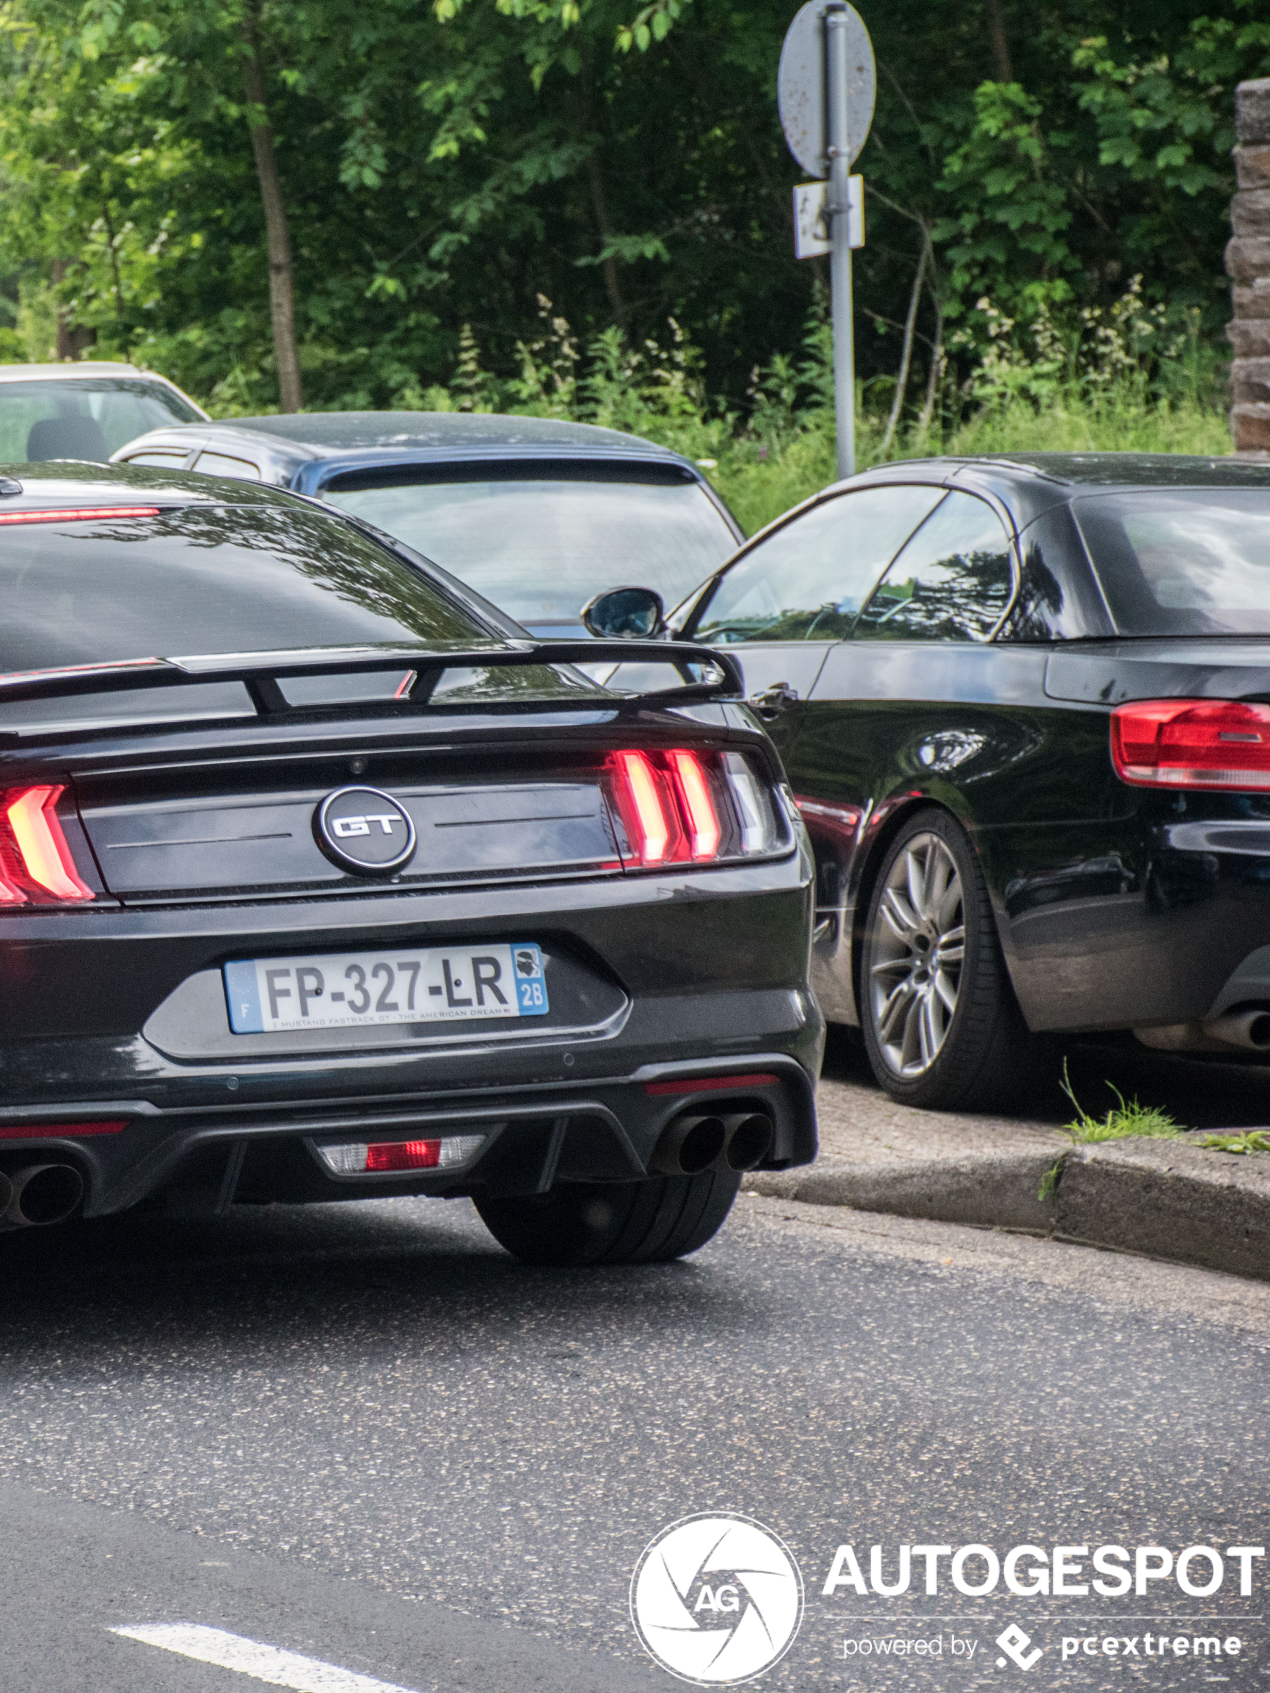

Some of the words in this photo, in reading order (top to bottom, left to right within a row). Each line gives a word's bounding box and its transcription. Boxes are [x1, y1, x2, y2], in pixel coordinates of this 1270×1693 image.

[332, 814, 403, 838] GT
[264, 956, 509, 1019] FP-327-LR
[520, 983, 543, 1006] 2B
[240, 1003, 250, 1018] F
[281, 1019, 326, 1028] MUSTANG
[329, 1016, 376, 1025] FASTBACK
[420, 1010, 467, 1019] AMERICAN
[470, 1008, 502, 1016] DREAM
